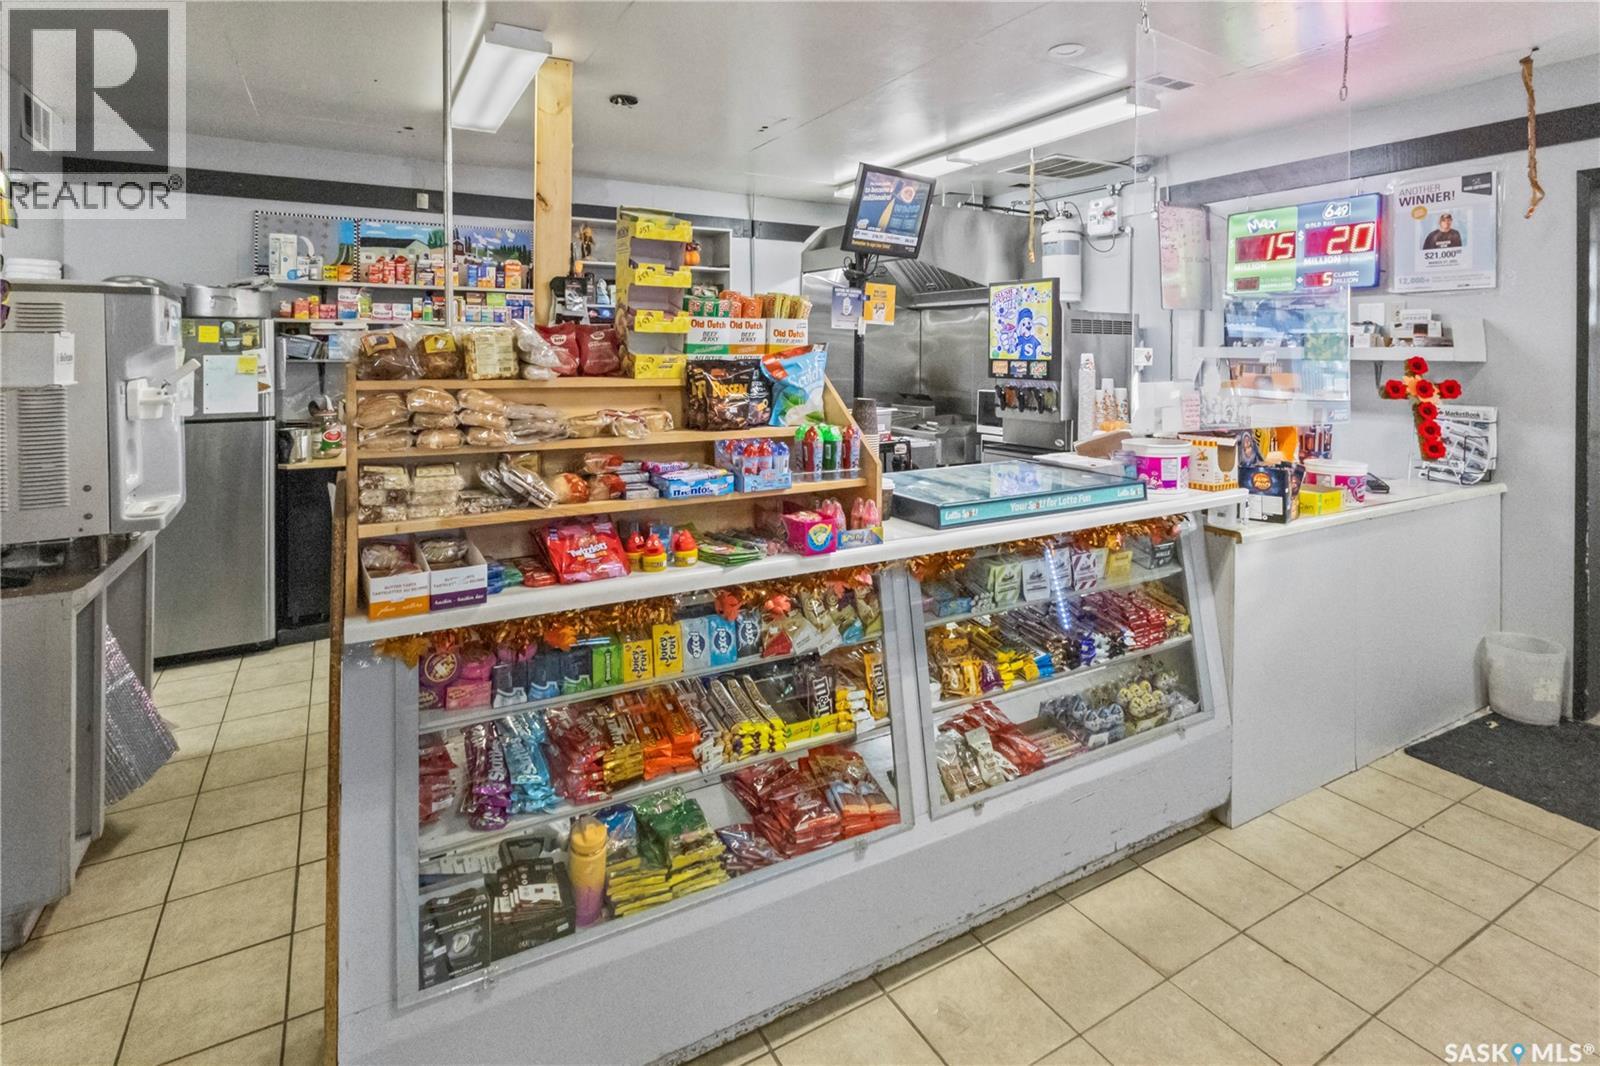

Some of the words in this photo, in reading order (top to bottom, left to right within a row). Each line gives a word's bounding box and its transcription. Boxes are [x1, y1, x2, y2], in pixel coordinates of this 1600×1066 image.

[1399, 183, 1441, 197] ANOTHER
[1399, 190, 1456, 207] WINNER!
[1326, 222, 1376, 255] 20
[1266, 231, 1295, 261] 15
[1304, 255, 1342, 265] MILLION
[1322, 271, 1334, 287] 5
[1333, 276, 1359, 284] MILLION
[690, 319, 705, 329] Old
[707, 320, 727, 329] Dutch
[729, 320, 744, 330] Old
[745, 321, 764, 330] Dutch
[773, 329, 787, 338] Old
[788, 330, 806, 338] Dutch
[1444, 409, 1481, 419] MarketBook
[673, 486, 714, 497] mentos
[1010, 502, 1027, 512] Your
[1046, 497, 1058, 507] for
[1058, 494, 1078, 505] Lotto
[1078, 493, 1092, 503] Fun
[689, 632, 702, 659] excel
[717, 627, 729, 654] excel
